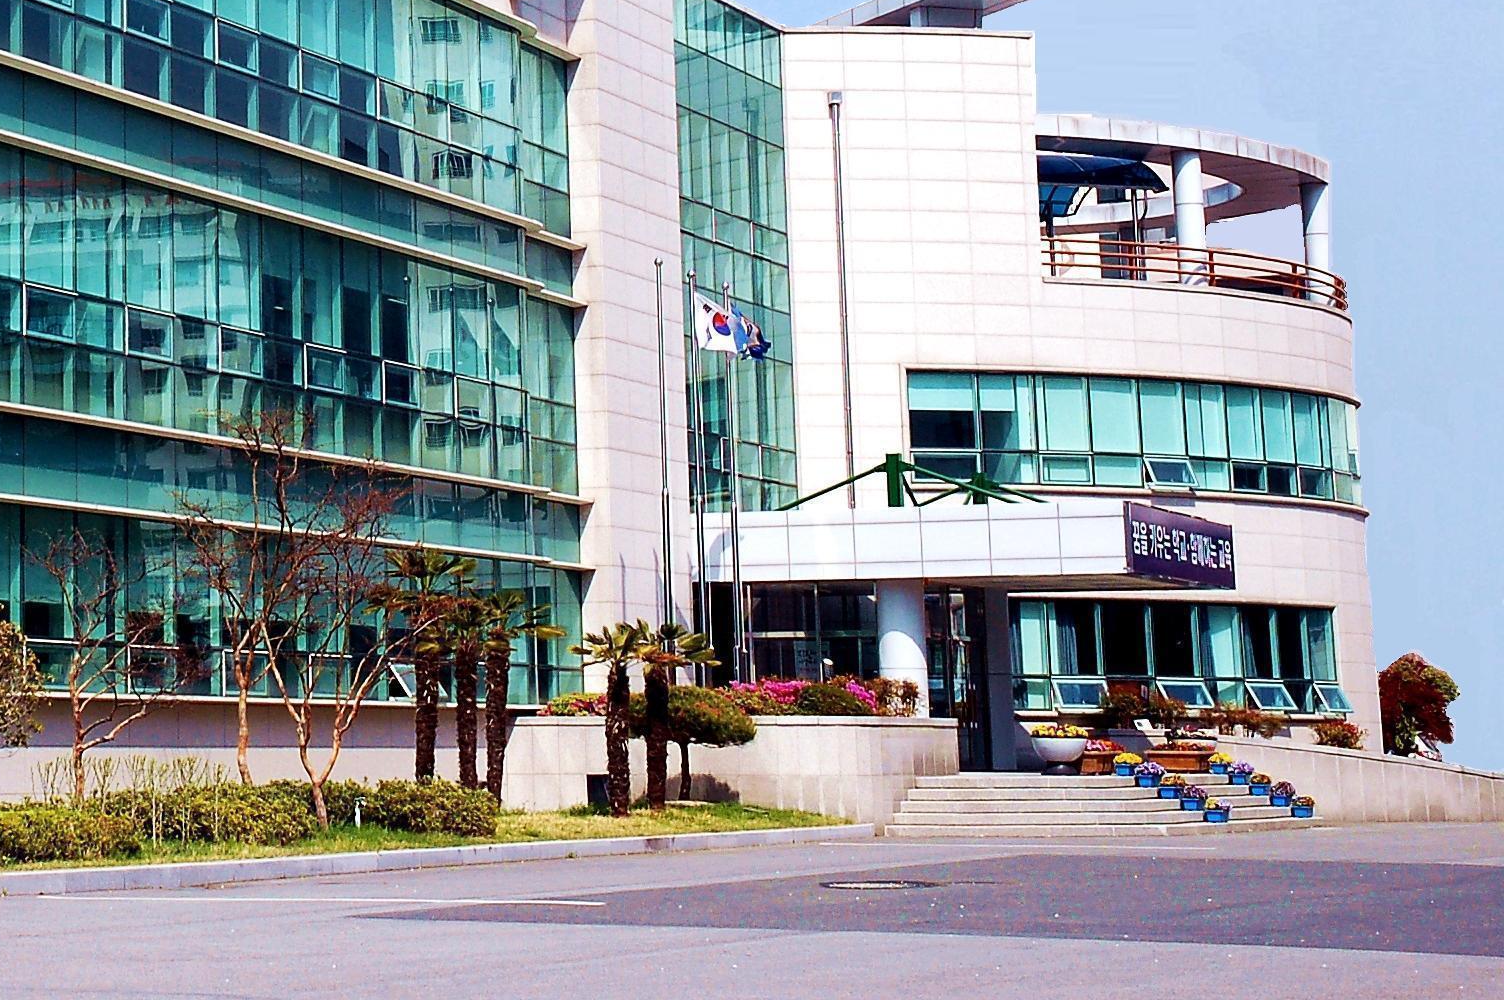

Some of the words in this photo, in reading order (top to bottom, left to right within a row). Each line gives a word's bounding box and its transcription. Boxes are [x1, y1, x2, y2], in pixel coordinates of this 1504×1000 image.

[1132, 520, 1148, 556] 꿈을
[1149, 524, 1172, 560] 키우는
[1217, 539, 1233, 572] 교육
